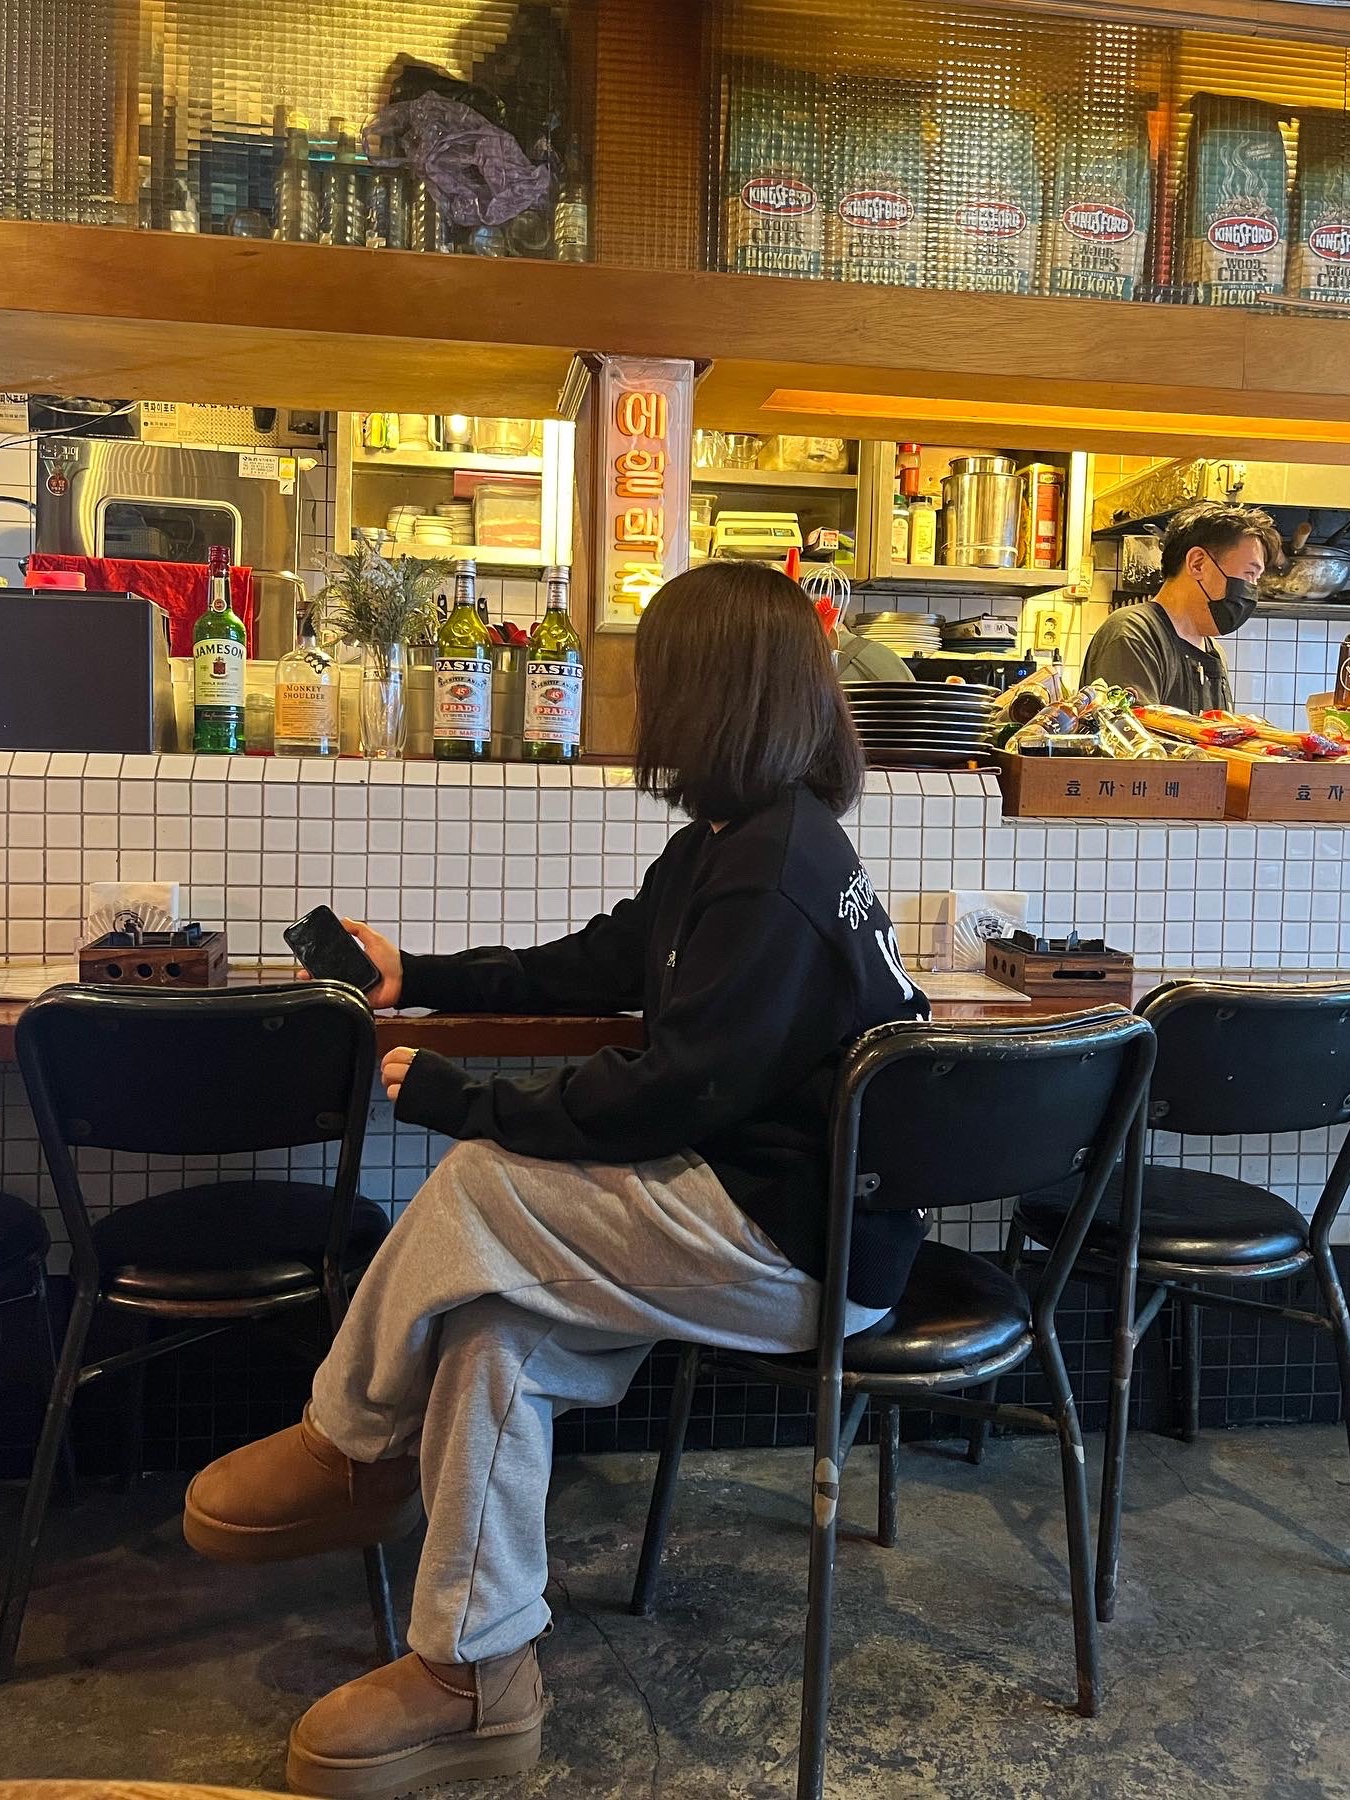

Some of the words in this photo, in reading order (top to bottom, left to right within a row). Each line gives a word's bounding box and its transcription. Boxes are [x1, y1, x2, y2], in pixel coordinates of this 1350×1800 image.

[748, 184, 812, 209] KINGSFORD
[1069, 209, 1129, 235] KINGSFORD
[1214, 222, 1273, 248] KINGSFORD
[744, 246, 813, 272] HICKORY
[1225, 257, 1261, 270] WOOD
[1217, 267, 1268, 282] CHIPS
[1060, 269, 1126, 297] HICKORY
[614, 391, 668, 613] 에일맥주
[195, 643, 244, 660] JAMESON
[435, 661, 491, 674] PASTIS
[528, 664, 584, 678] PASTIS
[286, 684, 322, 692] MONKEY
[455, 688, 466, 696] 45
[550, 691, 561, 699] 45
[283, 692, 326, 700] SHOULDER
[442, 704, 480, 713] PRADO
[535, 706, 573, 716] PRADO
